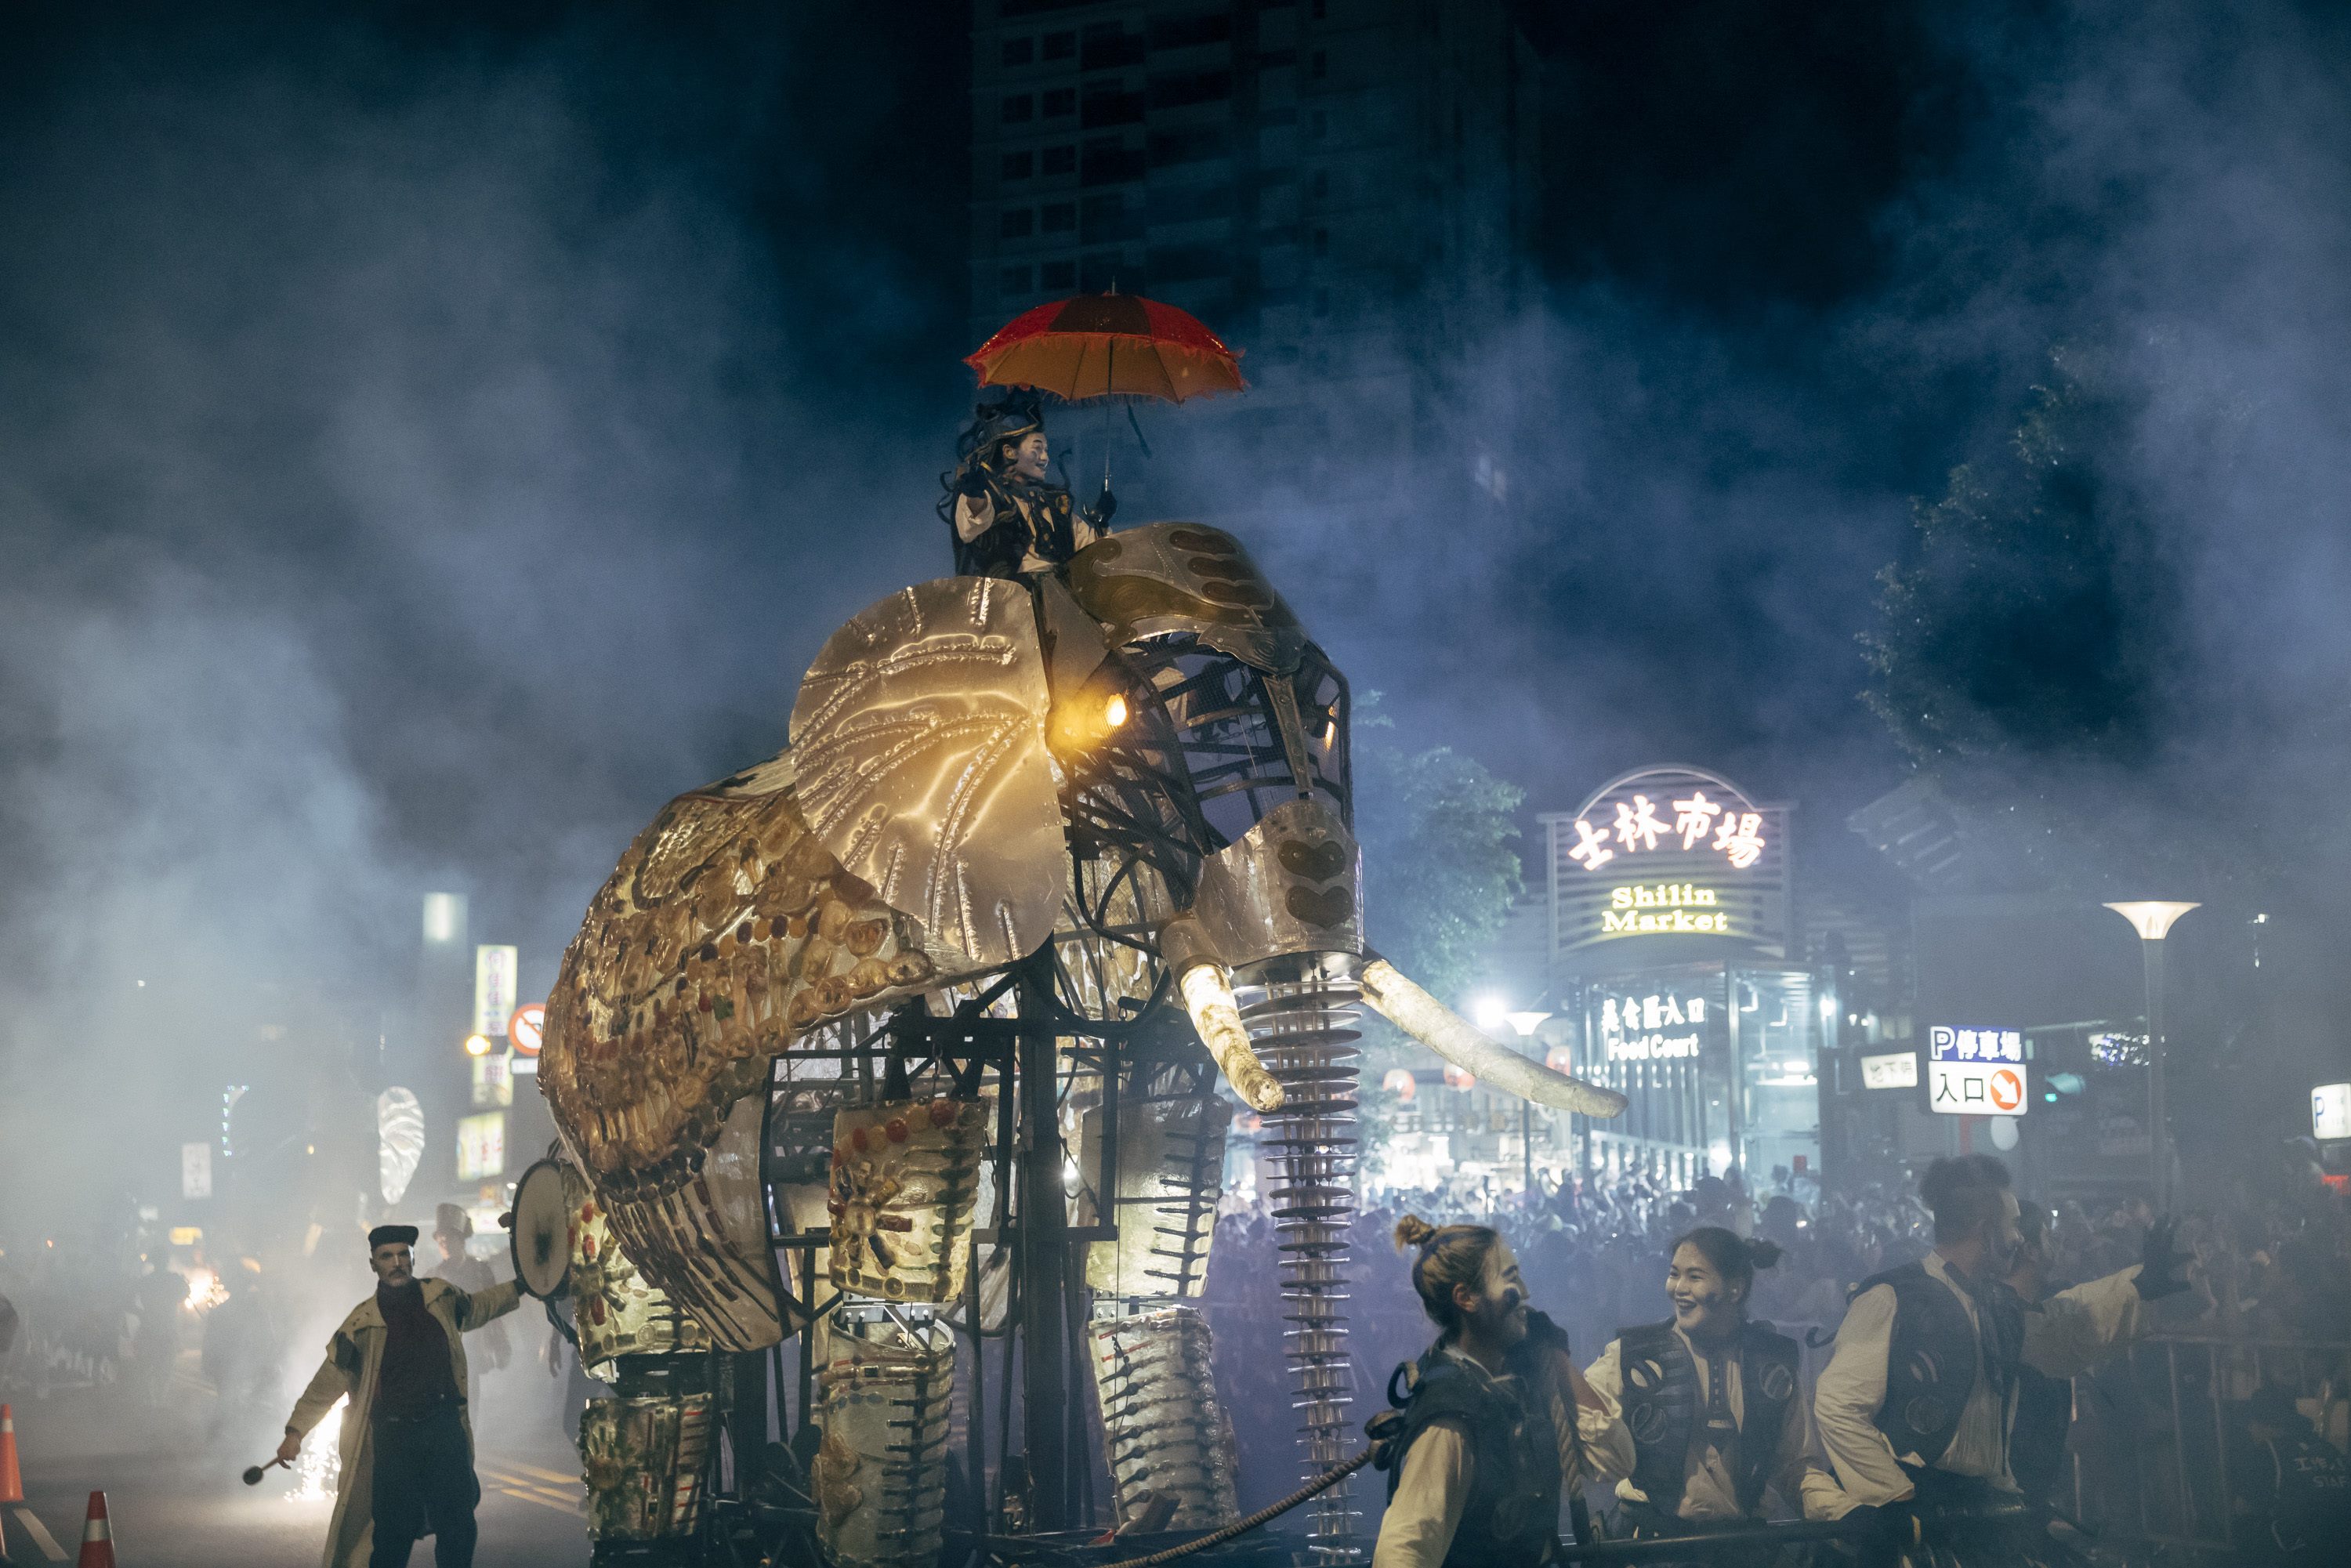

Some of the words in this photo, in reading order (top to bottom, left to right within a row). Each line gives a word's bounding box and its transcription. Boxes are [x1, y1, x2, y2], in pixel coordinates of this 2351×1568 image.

[1568, 791, 1765, 871] 士林市場
[1611, 883, 1717, 909] Shilin
[1601, 909, 1728, 932] Market
[1608, 1035, 1649, 1061] Food
[1650, 1033, 1699, 1059] Court
[1936, 1073, 1984, 1103] 入口
[2315, 1096, 2324, 1128] P
